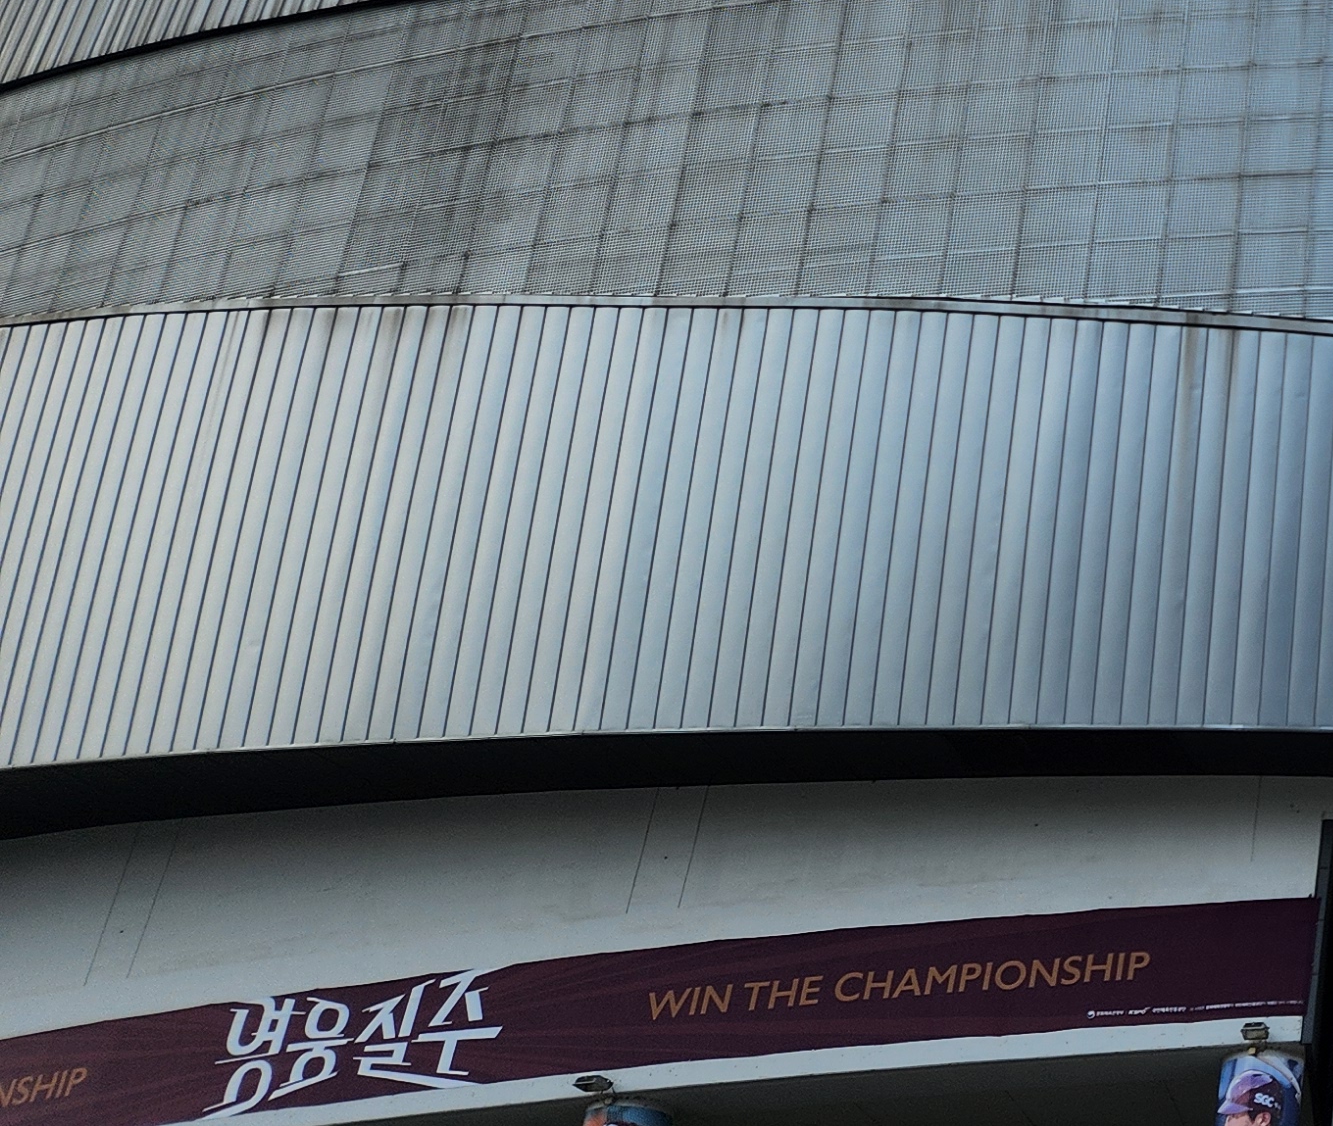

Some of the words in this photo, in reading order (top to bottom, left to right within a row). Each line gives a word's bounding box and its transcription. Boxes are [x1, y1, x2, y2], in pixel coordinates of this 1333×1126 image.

[649, 983, 733, 1021] WIN
[744, 975, 824, 1012] THE
[834, 950, 1151, 1002] CHAMPIONSHIP
[203, 966, 503, 1119] 영웅질주
